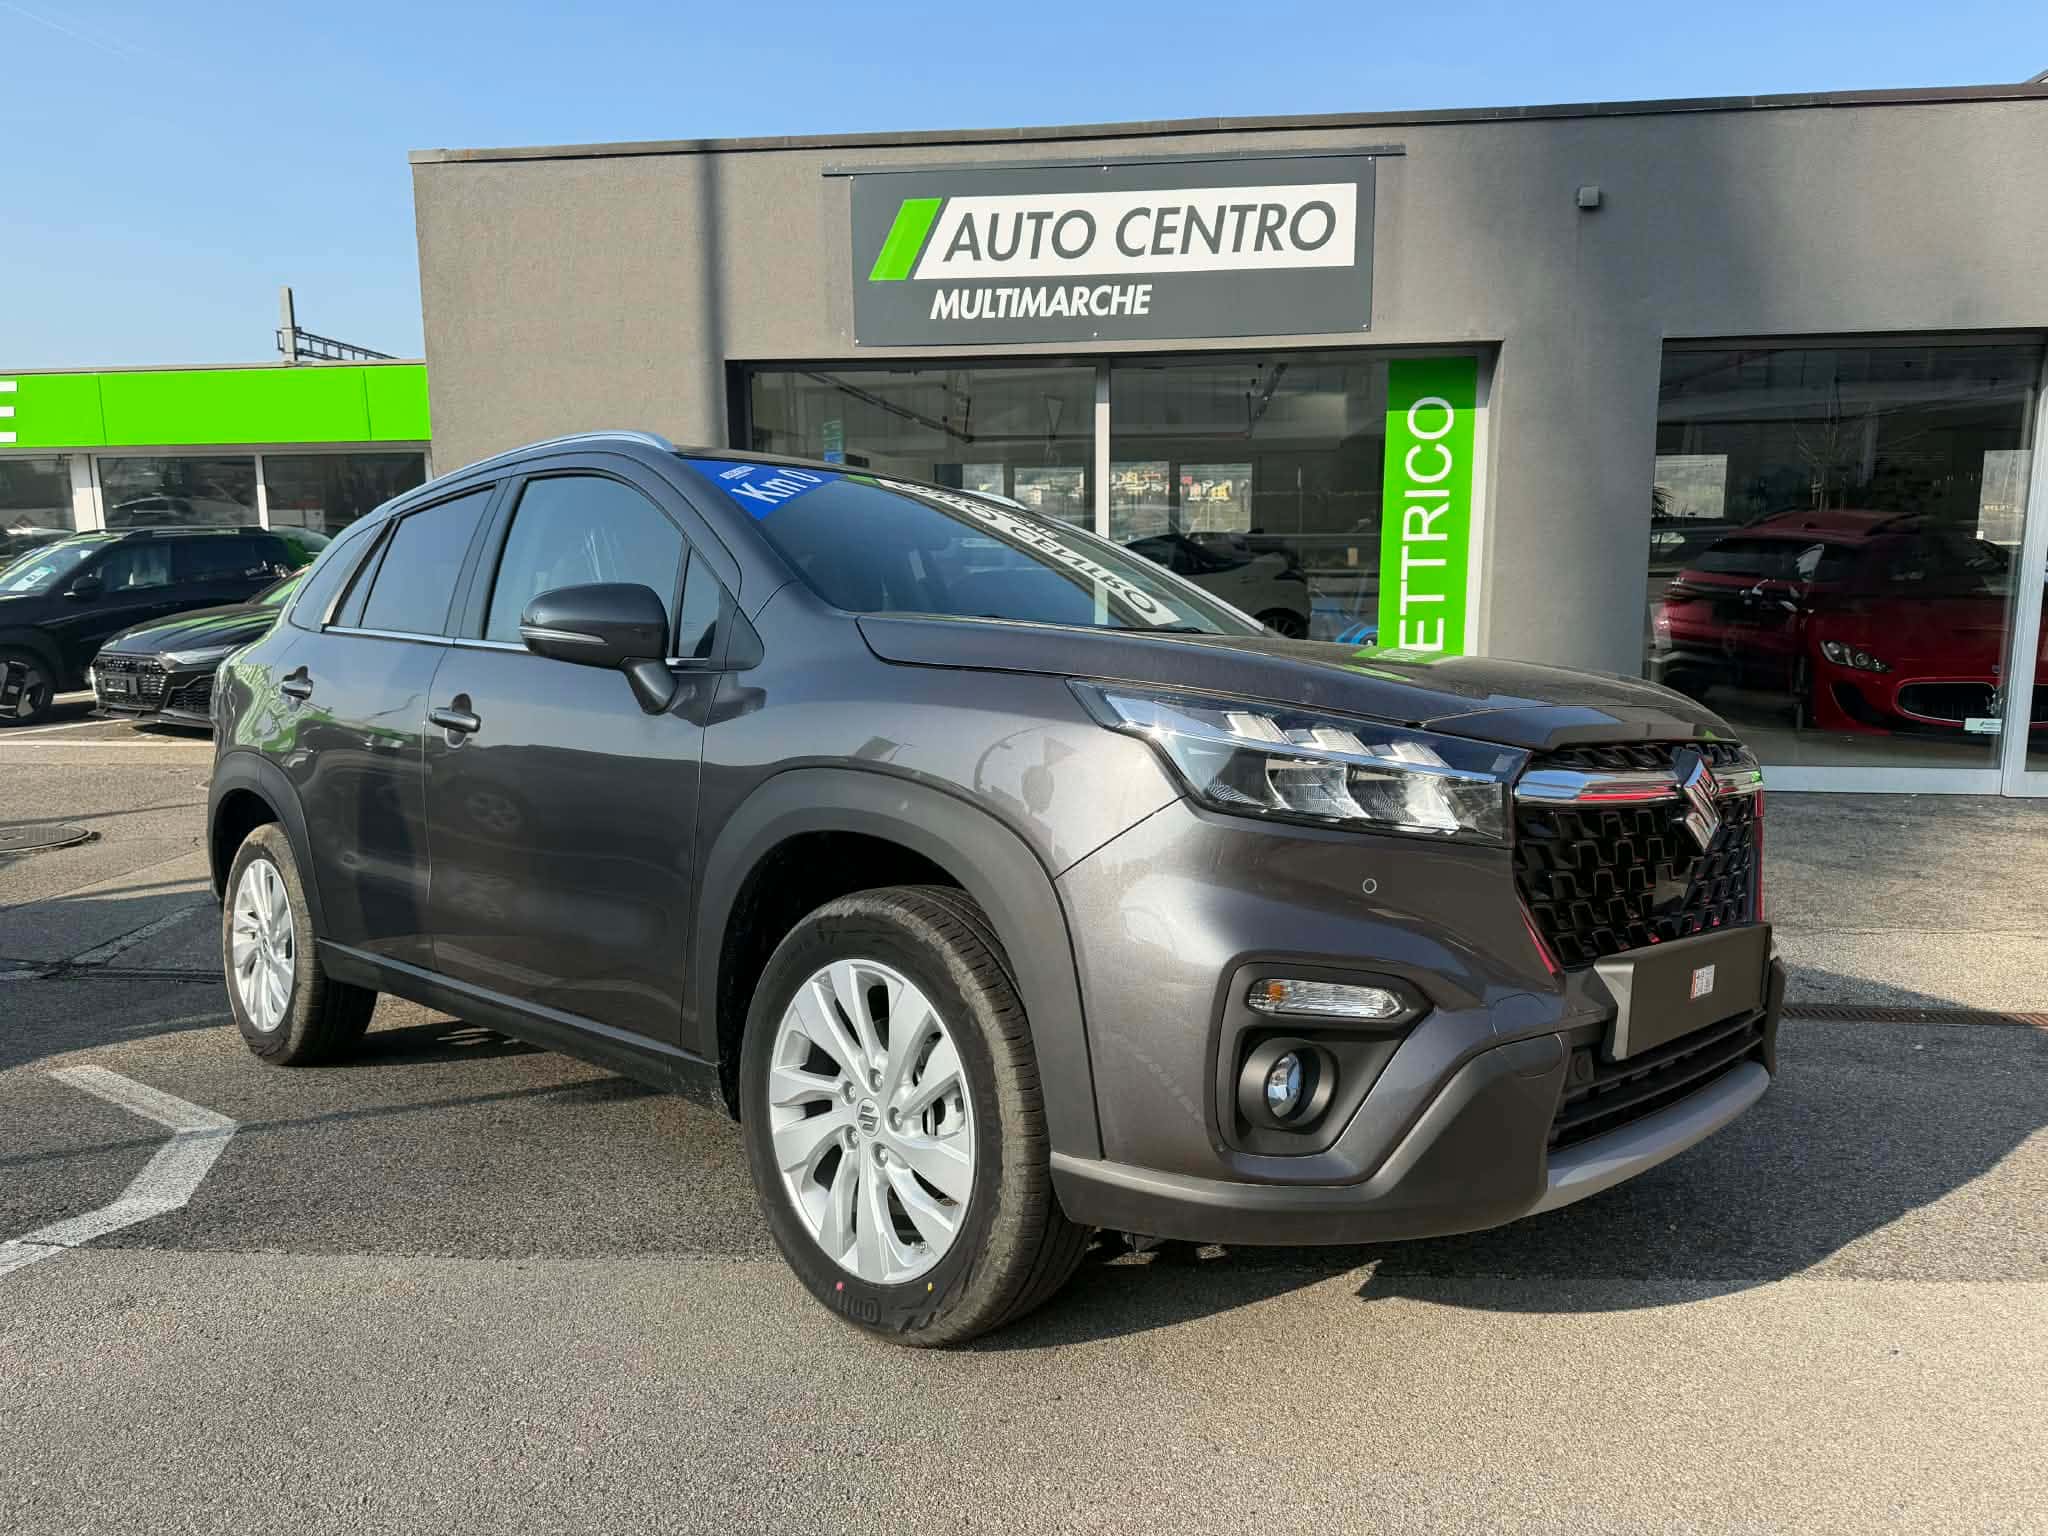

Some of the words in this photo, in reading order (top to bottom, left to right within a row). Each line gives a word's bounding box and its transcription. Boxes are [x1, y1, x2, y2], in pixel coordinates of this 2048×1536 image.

[942, 208, 1097, 263] AUTO
[1114, 200, 1337, 257] CENTRO
[930, 283, 1153, 320] MULTIMARCHE
[730, 478, 808, 504] Km
[1398, 396, 1455, 652] ETTRICO
